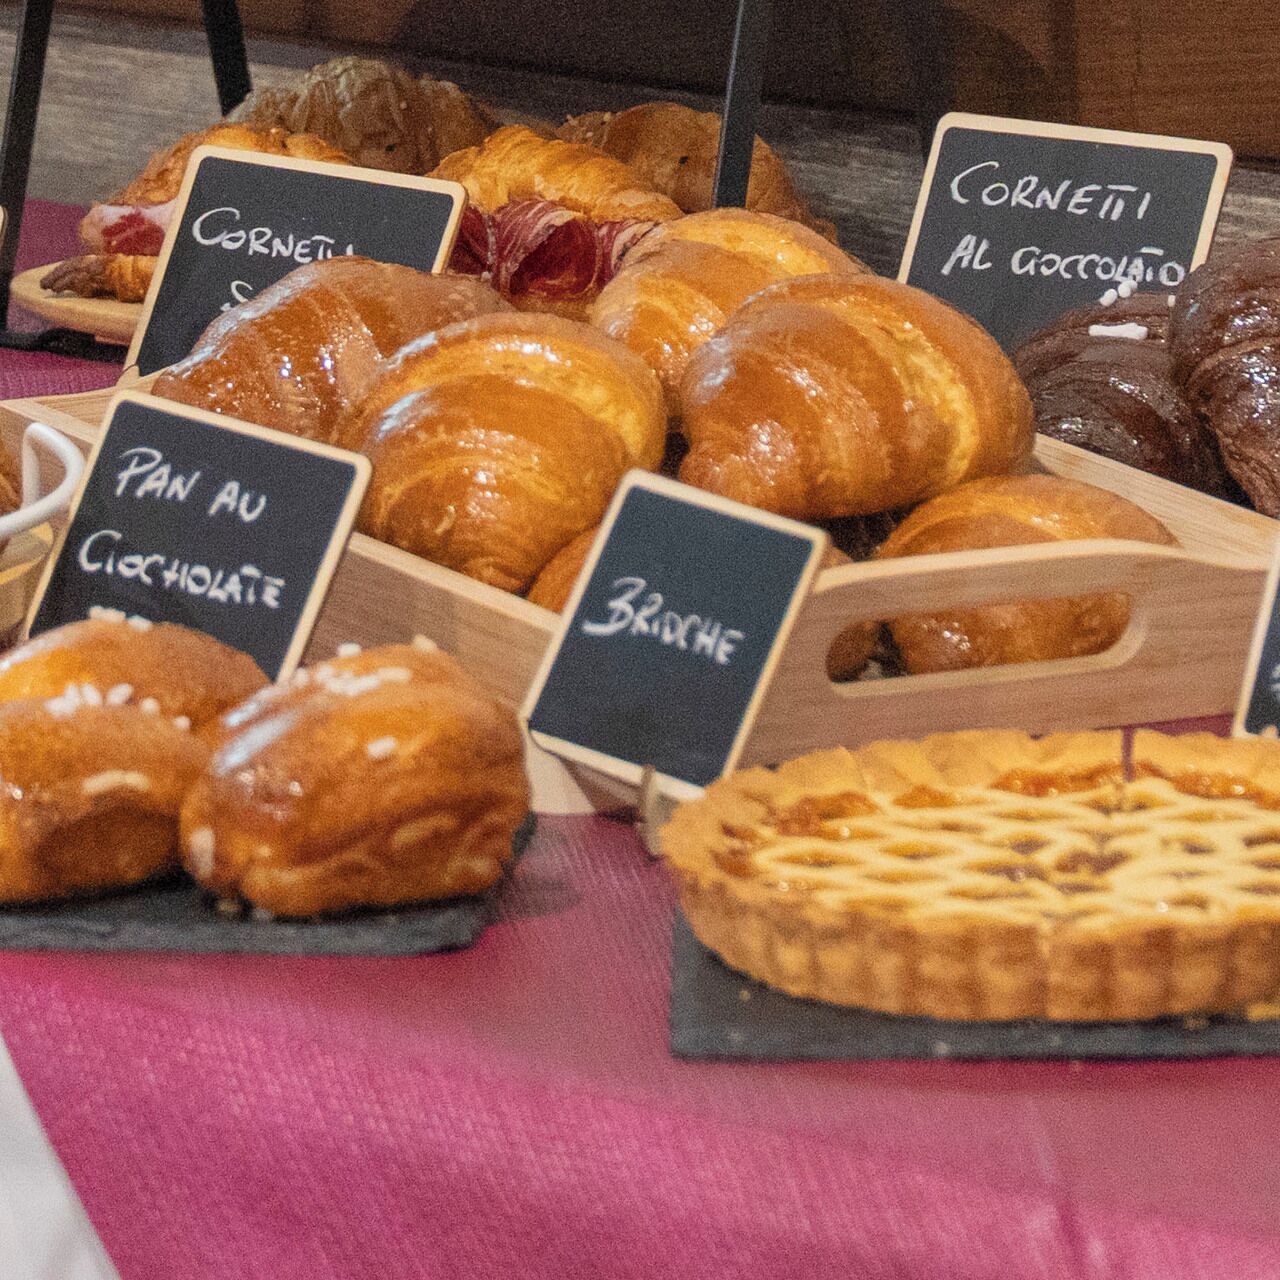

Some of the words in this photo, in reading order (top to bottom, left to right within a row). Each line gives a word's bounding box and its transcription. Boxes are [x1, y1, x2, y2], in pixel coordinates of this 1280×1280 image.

[950, 161, 1151, 221] CORNETTI
[941, 234, 992, 275] AL
[116, 447, 200, 501] PAN
[209, 481, 266, 522] AU
[582, 576, 744, 664] BRIOCHE
